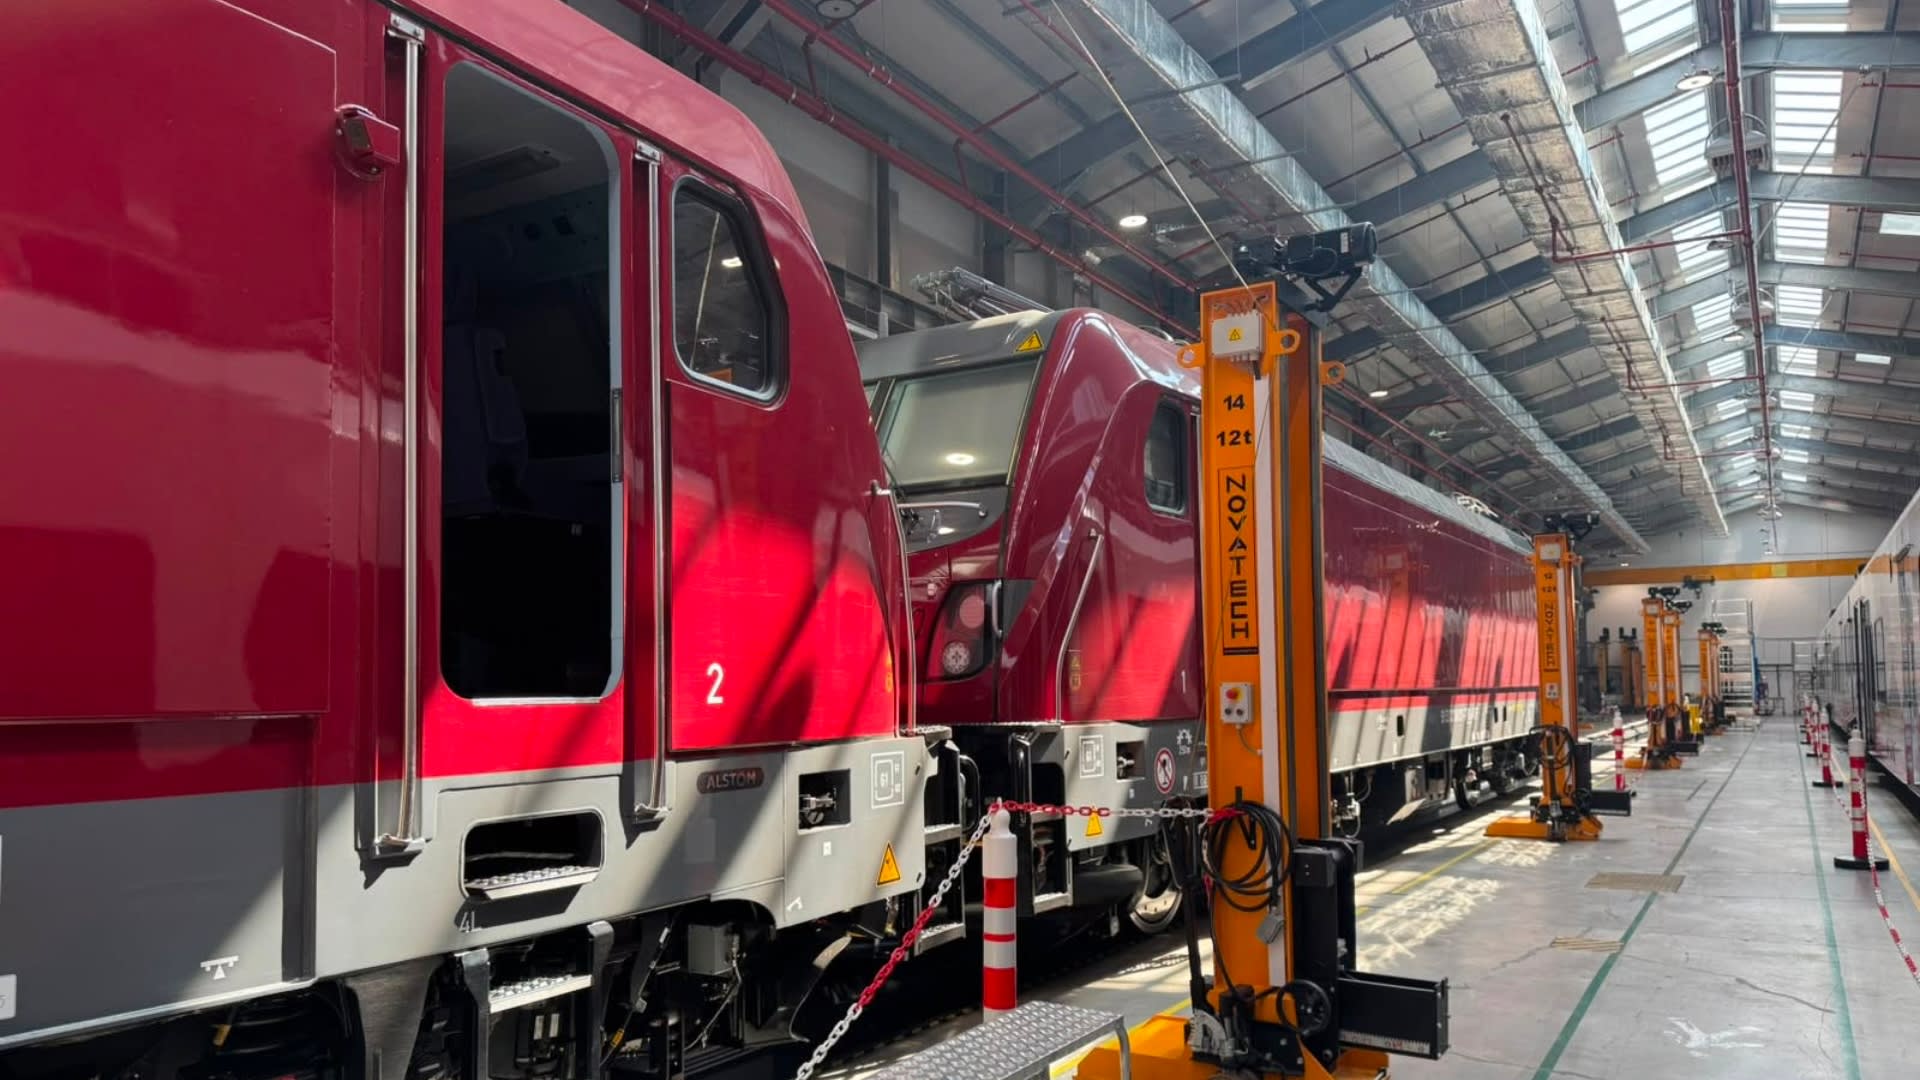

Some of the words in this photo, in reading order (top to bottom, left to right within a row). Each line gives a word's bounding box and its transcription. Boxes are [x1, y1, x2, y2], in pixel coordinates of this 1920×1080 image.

[1223, 394, 1246, 411] 14
[1217, 430, 1253, 447] 12t
[1225, 473, 1249, 640] NOVATECH
[707, 662, 724, 704] 2
[1181, 669, 1187, 694] 1
[706, 768, 757, 790] ALSTOM
